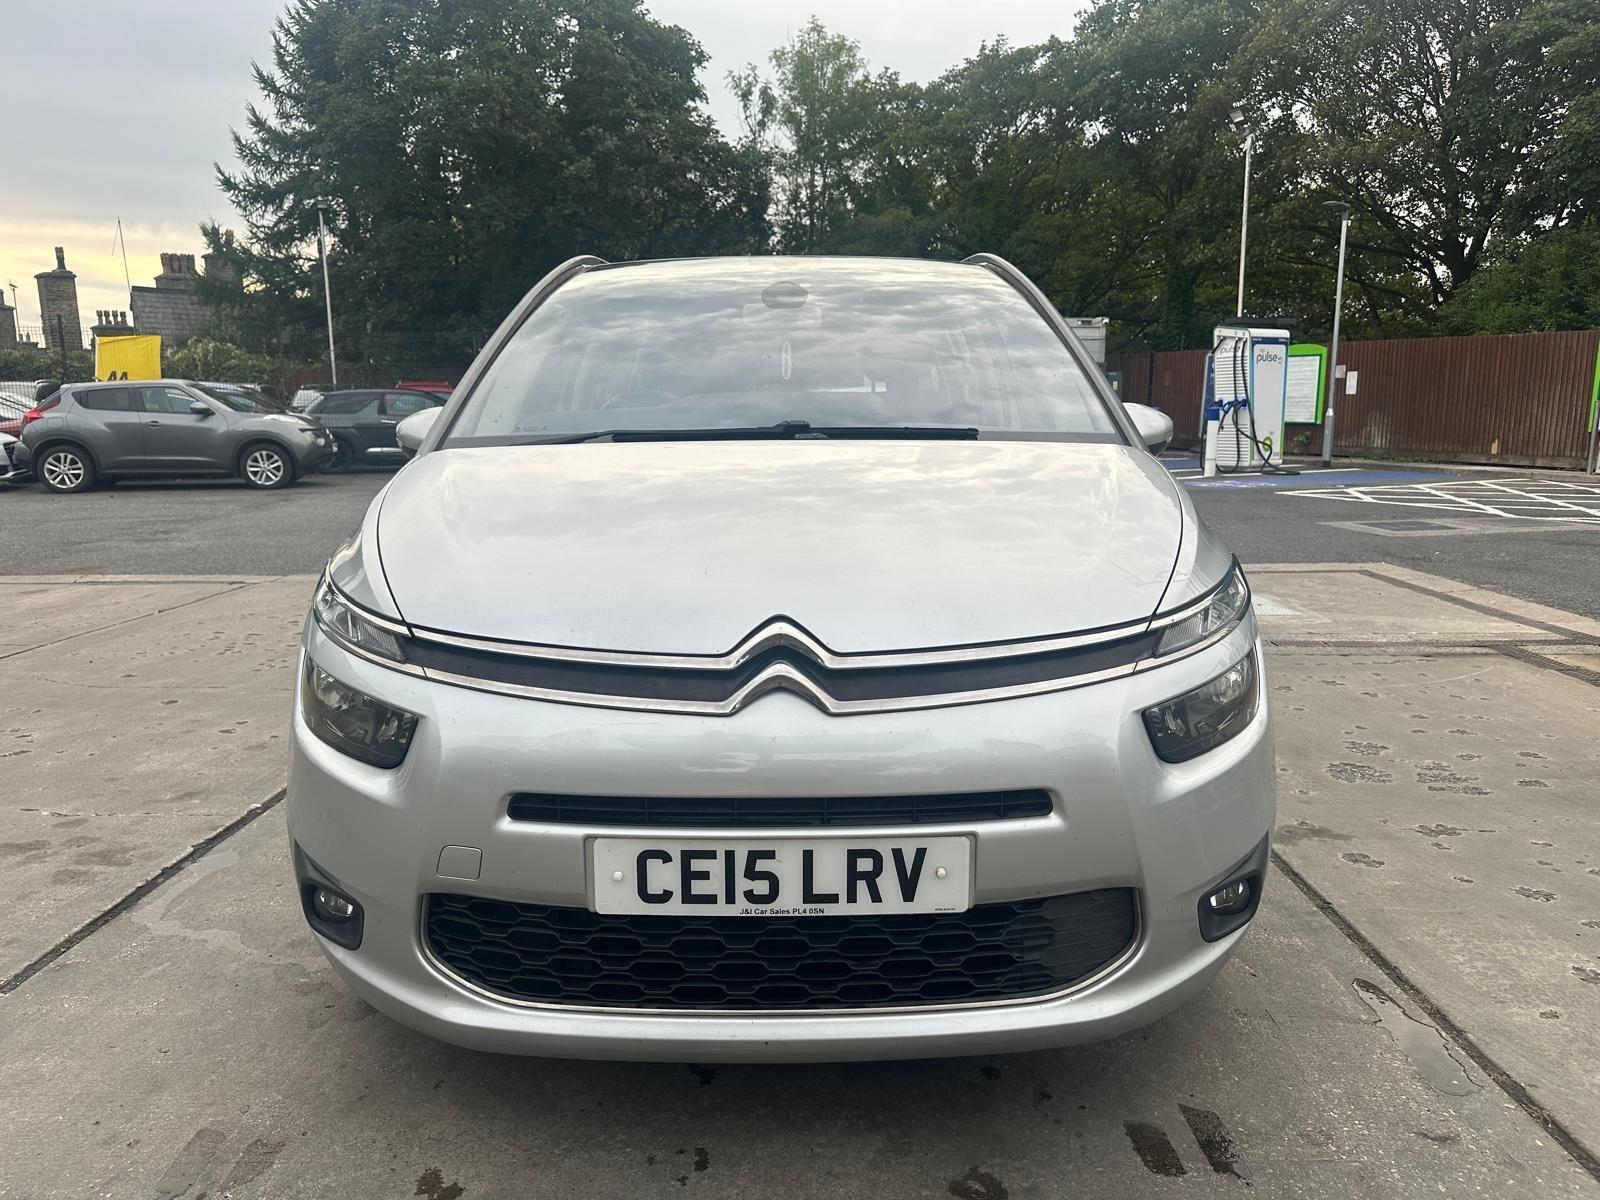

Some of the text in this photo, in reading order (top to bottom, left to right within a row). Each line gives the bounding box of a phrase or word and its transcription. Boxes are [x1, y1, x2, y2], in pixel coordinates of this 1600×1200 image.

[1256, 351, 1278, 364] pulse
[637, 847, 927, 905] CE15 LRV
